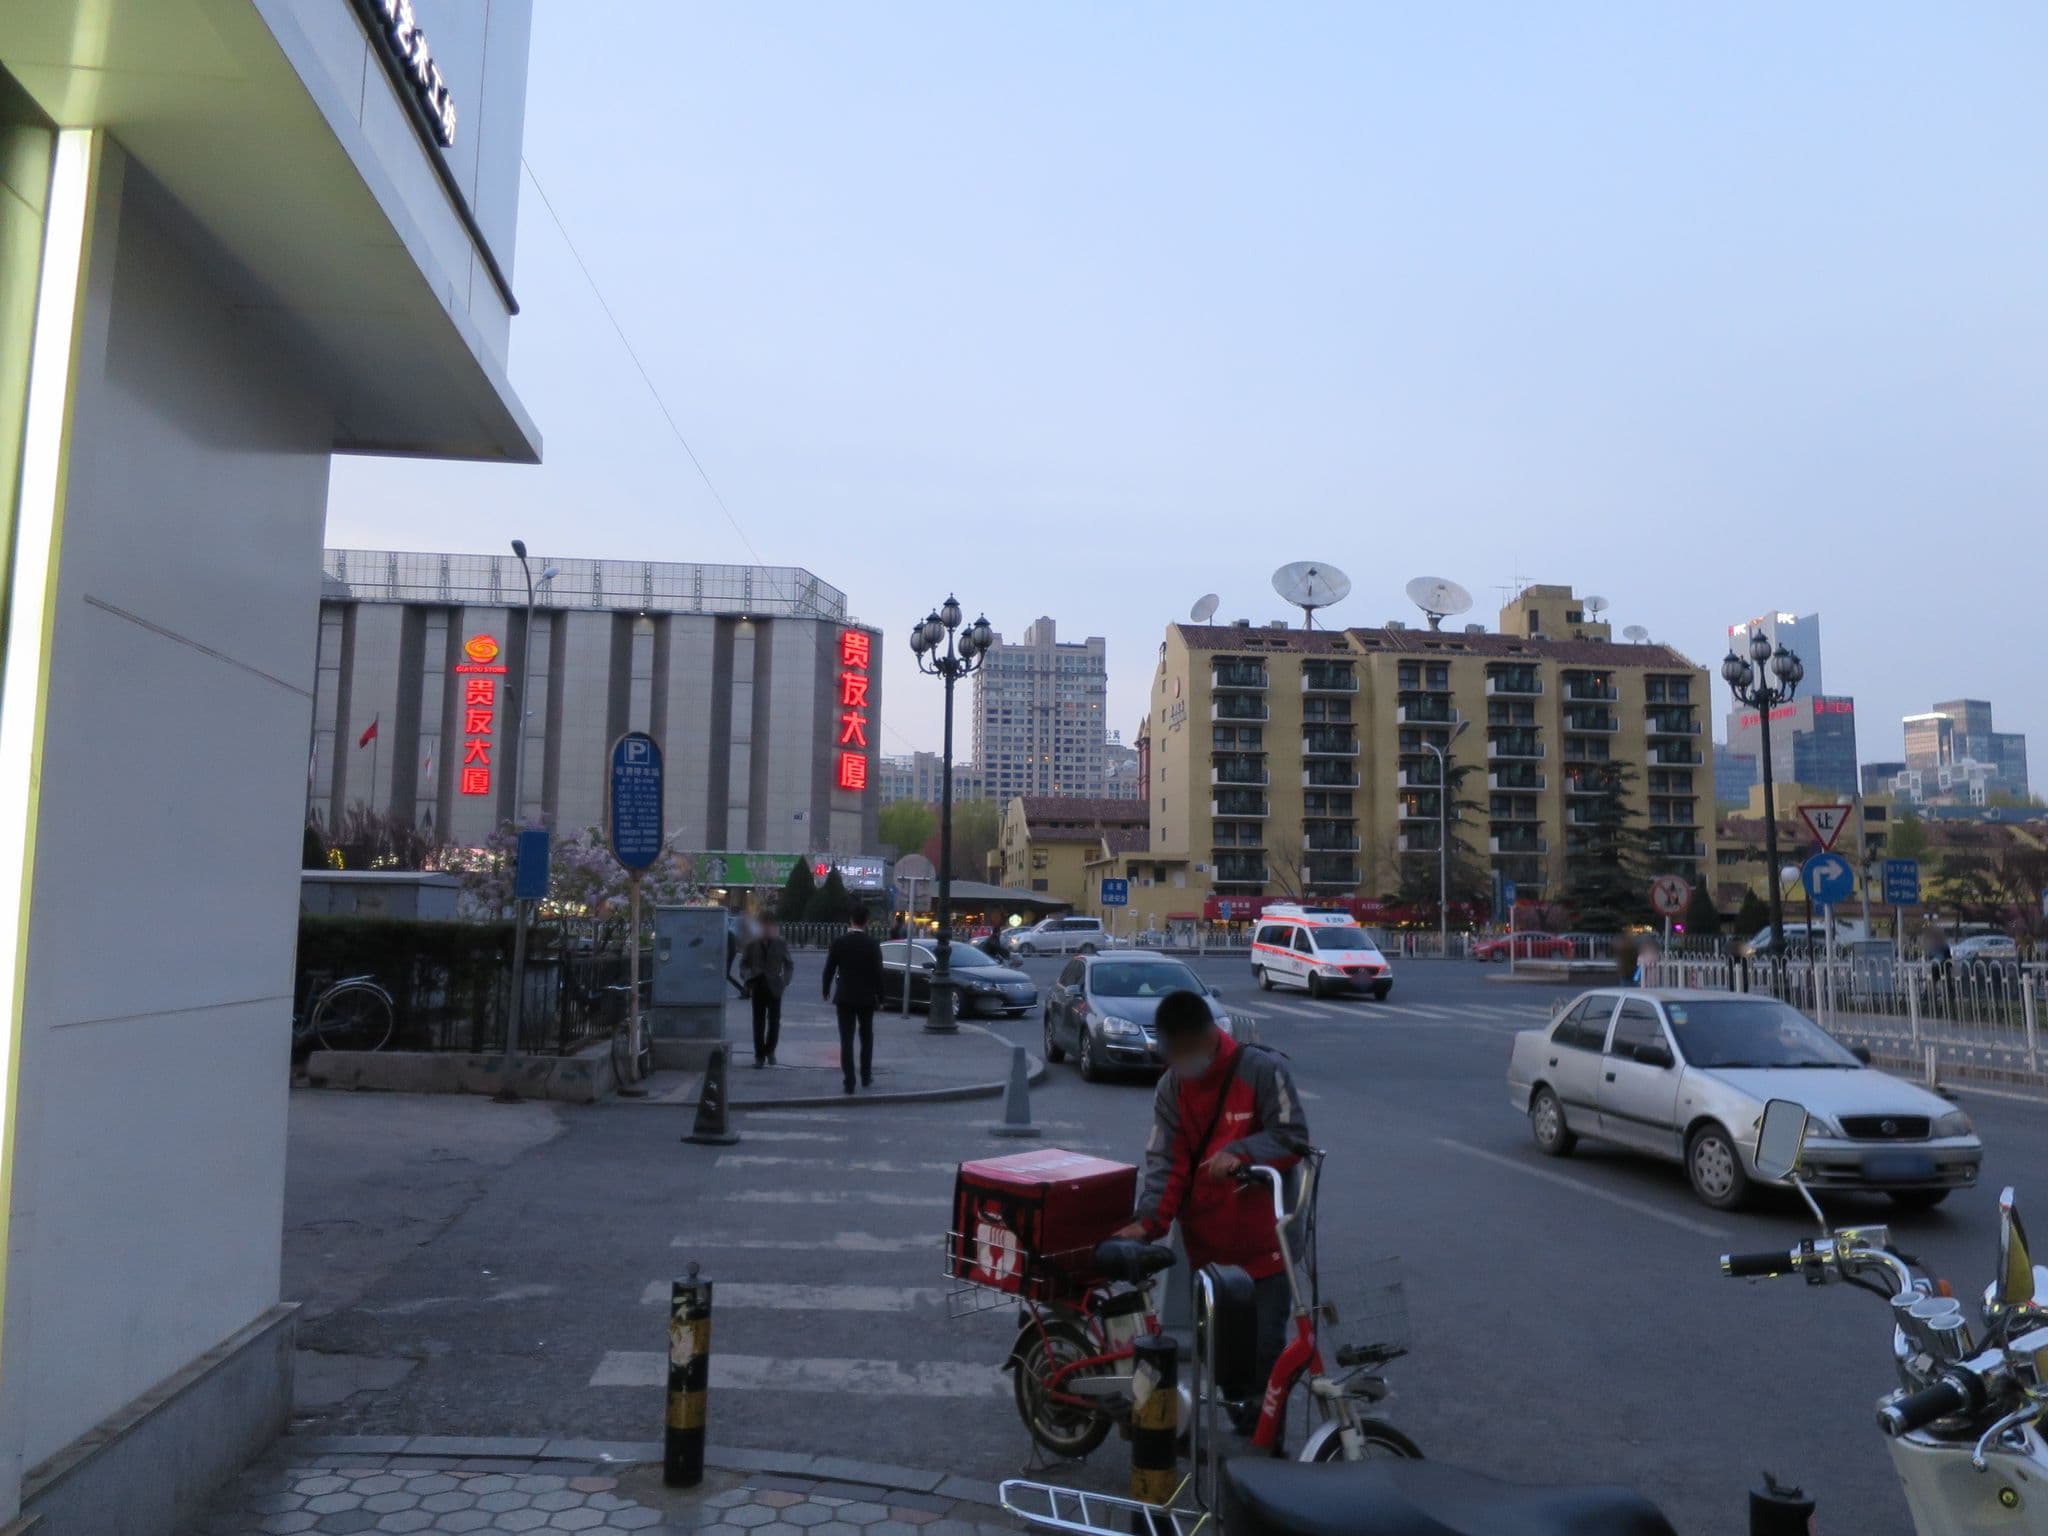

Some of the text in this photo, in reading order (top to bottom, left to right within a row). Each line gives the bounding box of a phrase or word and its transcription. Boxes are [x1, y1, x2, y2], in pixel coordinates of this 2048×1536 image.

[385, 0, 457, 145] 艺术工坊
[461, 679, 494, 795] 贵友大厦
[628, 741, 646, 761] P
[841, 631, 869, 789] 贵友大厦
[1816, 812, 1834, 830] 让
